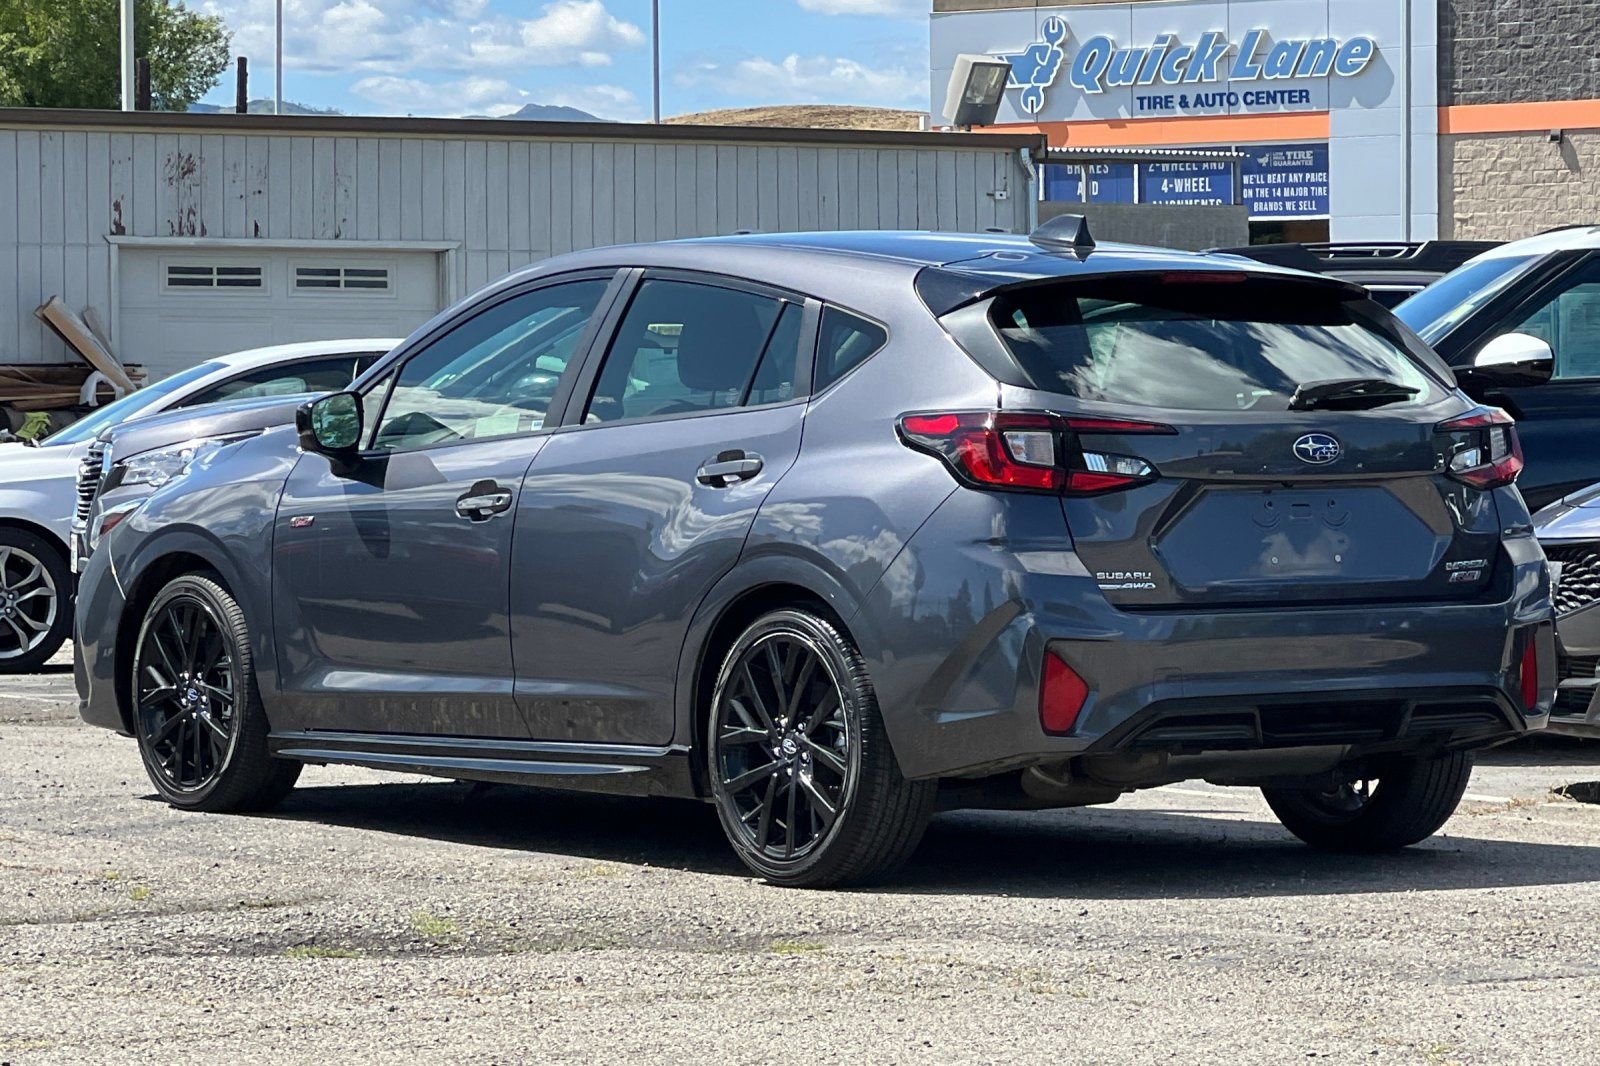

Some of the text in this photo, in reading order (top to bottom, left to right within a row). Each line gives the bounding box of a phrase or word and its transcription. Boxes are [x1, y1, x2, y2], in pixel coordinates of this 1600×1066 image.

[1070, 29, 1374, 94] Quick Lane
[1136, 89, 1311, 110] TIRE & AUTO CENTER
[1286, 150, 1313, 160] TIRE
[1066, 164, 1109, 175] BRKES
[1243, 172, 1328, 185] WE'LL BEAT ANY PRICE
[1161, 177, 1212, 193] 4-WHEEL
[1243, 186, 1328, 199] ON THE 14 MAJOR TIRE
[1253, 200, 1317, 212] BRANDS WE SELL
[1096, 572, 1152, 580] SUBARU
[1121, 582, 1157, 590] AWD
